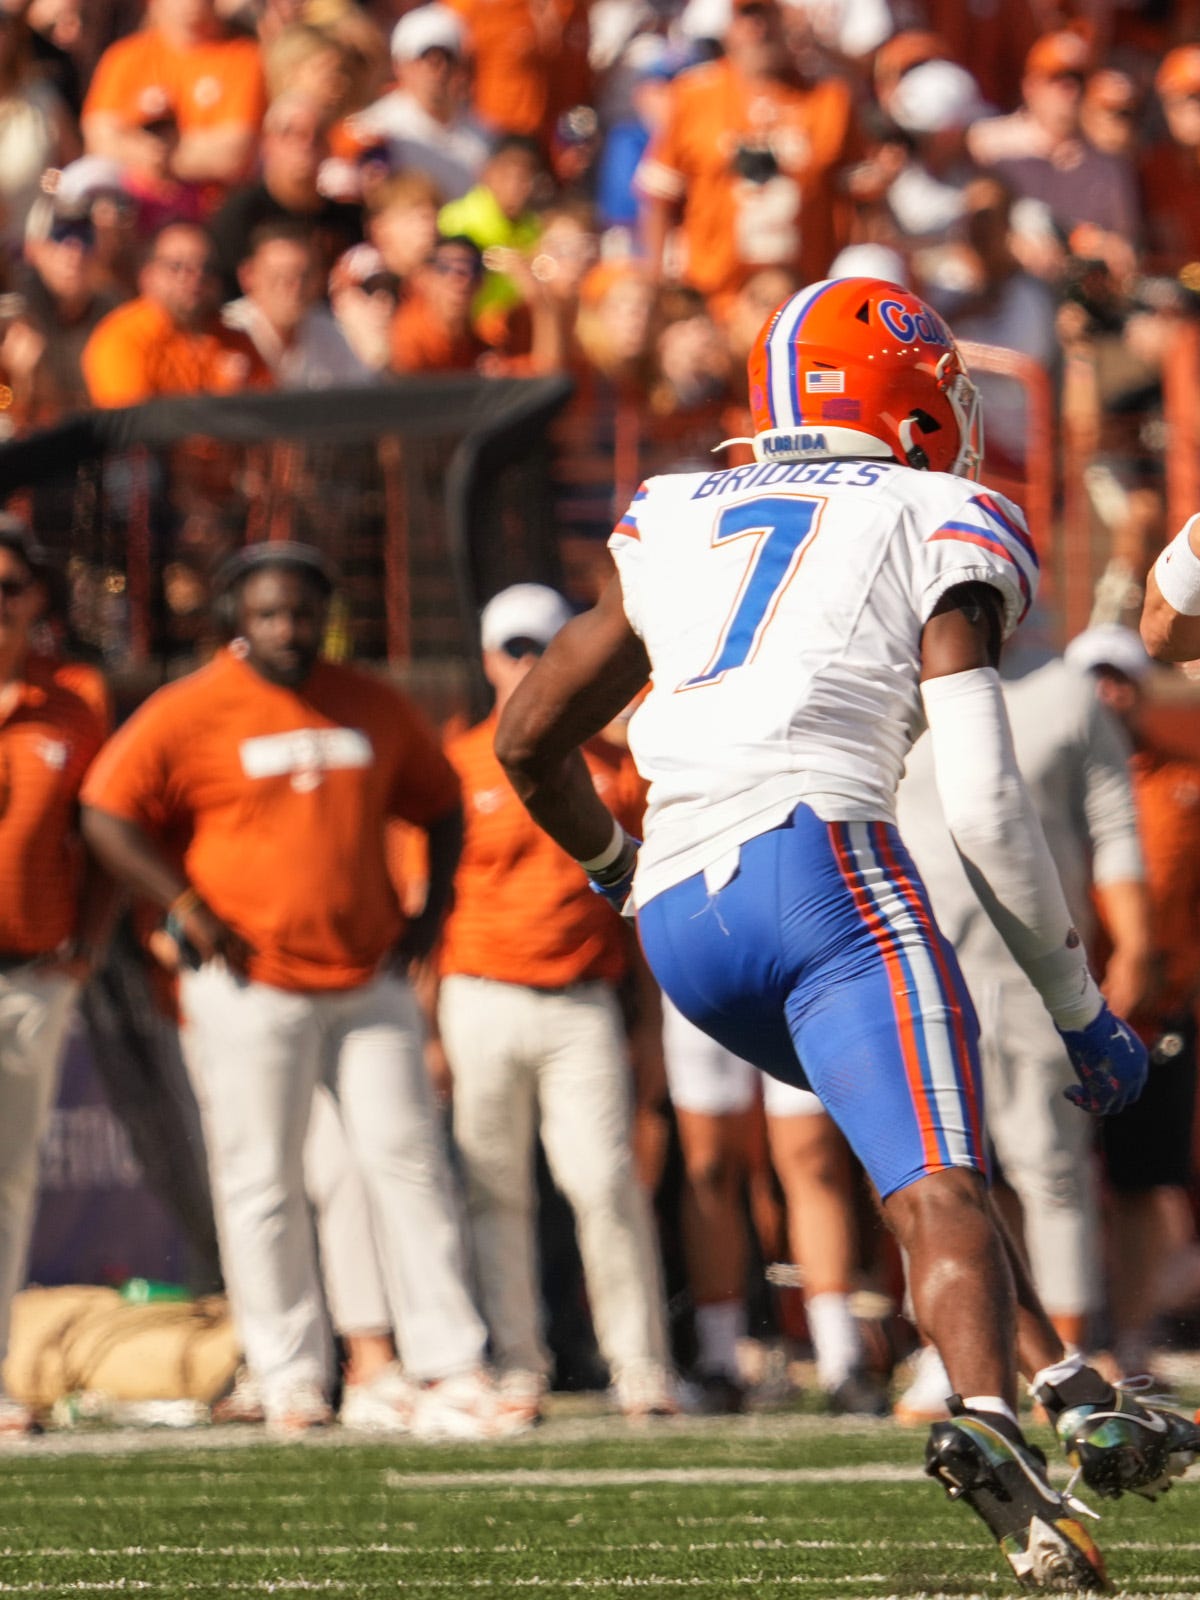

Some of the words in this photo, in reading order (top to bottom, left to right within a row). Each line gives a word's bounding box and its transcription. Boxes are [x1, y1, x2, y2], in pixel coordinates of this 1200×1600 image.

[878, 299, 953, 349] Gat
[762, 432, 827, 455] FLORIDA
[690, 461, 890, 500] BRIDGES
[674, 493, 828, 693] 7
